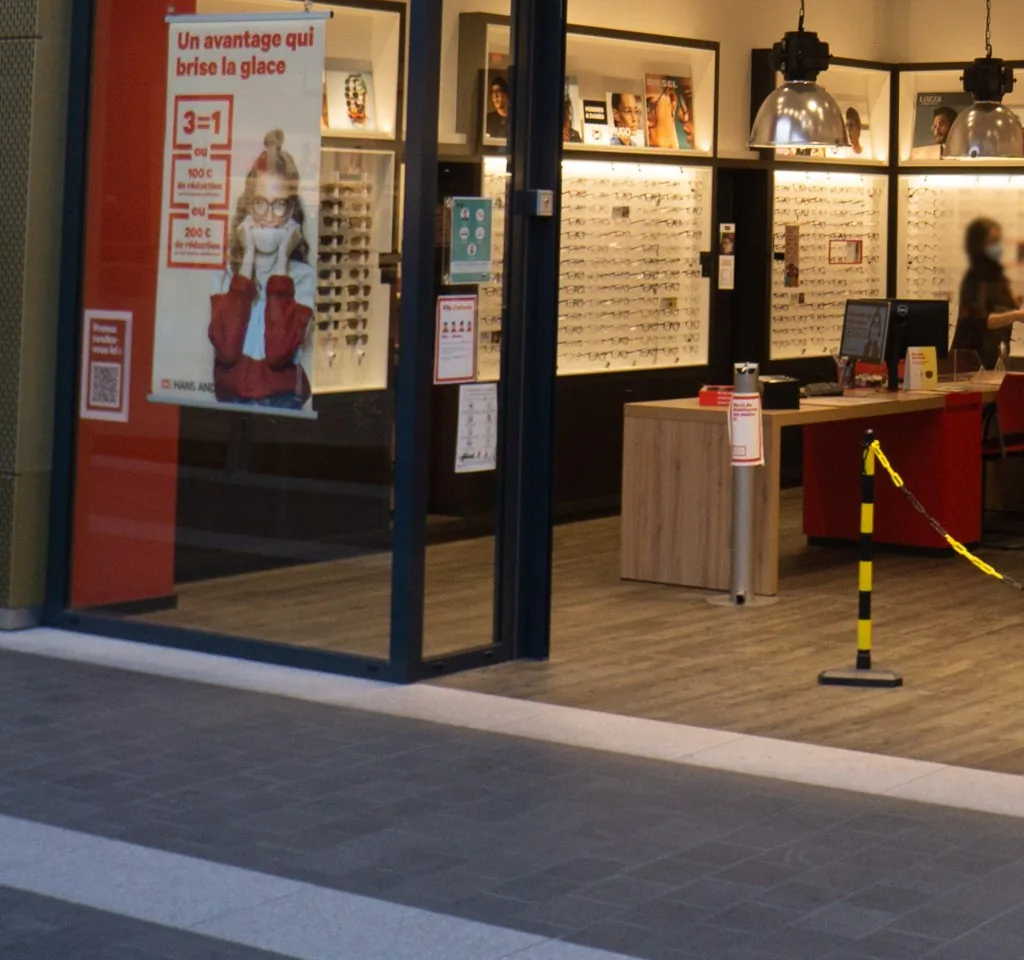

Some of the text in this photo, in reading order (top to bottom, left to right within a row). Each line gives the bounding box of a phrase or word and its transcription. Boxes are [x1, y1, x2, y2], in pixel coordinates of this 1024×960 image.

[177, 26, 315, 52] Un avantage qui
[175, 54, 286, 79] brise la glace
[183, 110, 221, 134] 3=1
[194, 147, 208, 157] ou
[191, 207, 206, 217] ou
